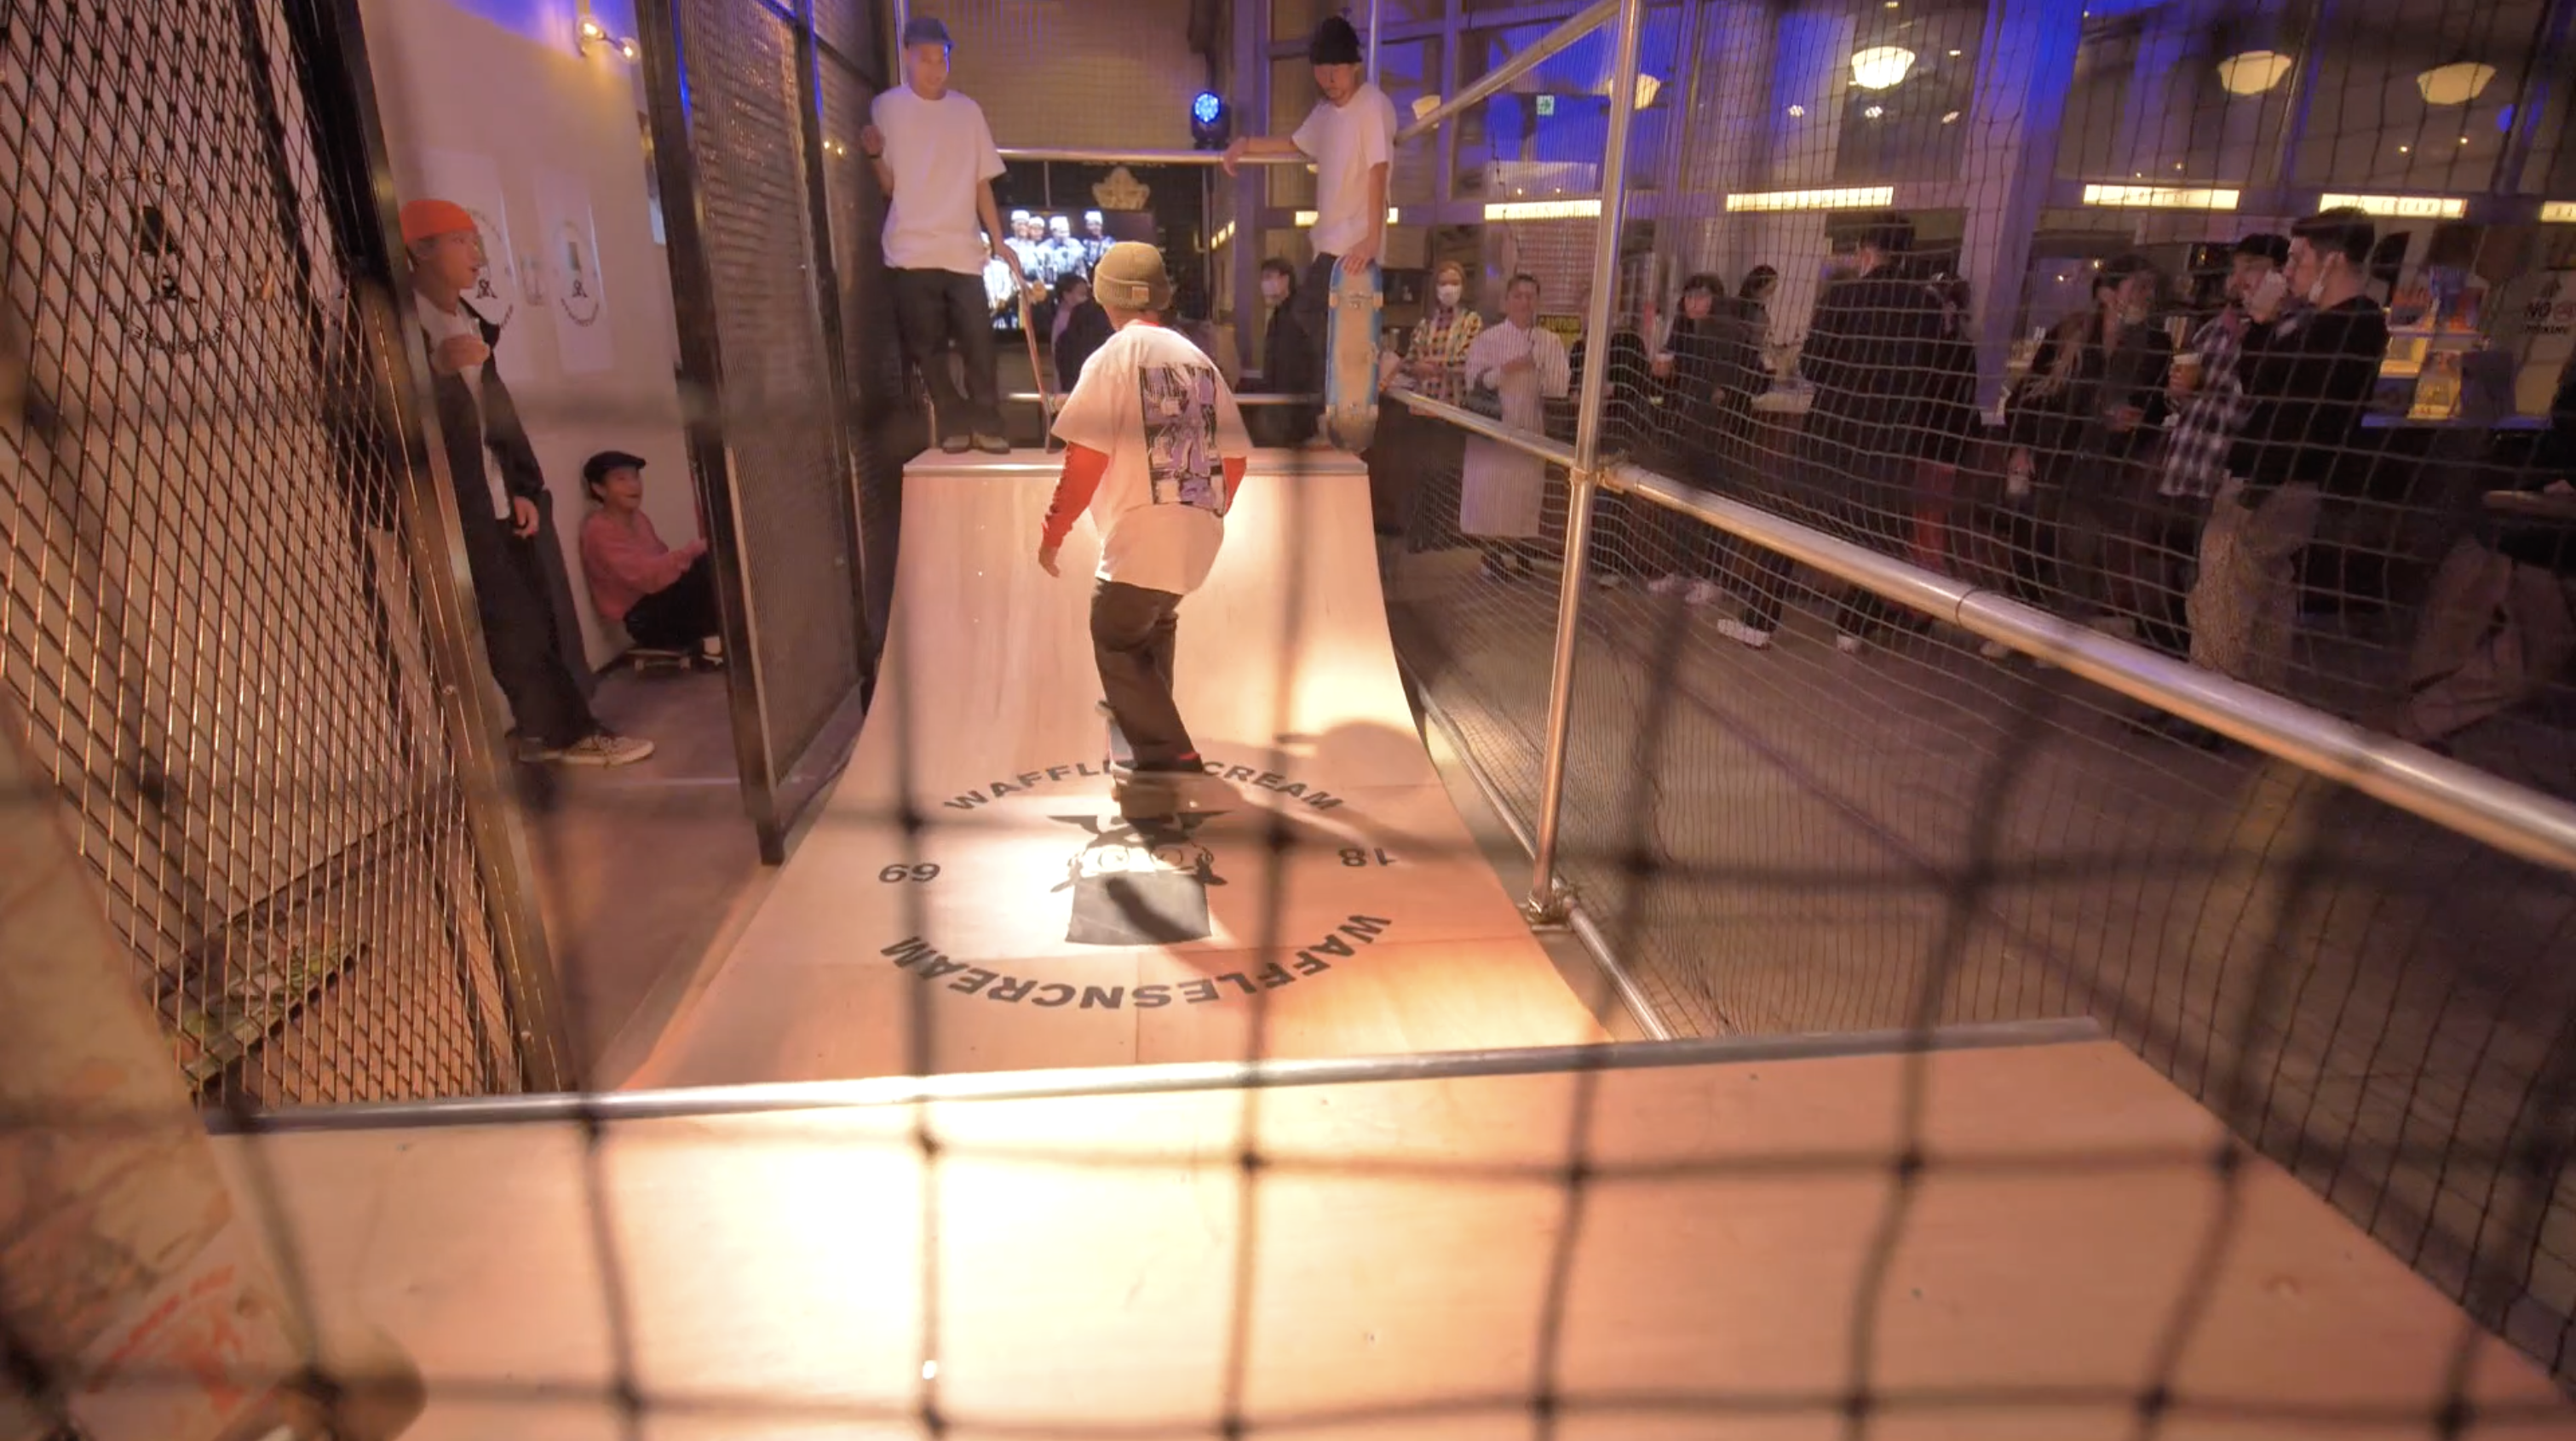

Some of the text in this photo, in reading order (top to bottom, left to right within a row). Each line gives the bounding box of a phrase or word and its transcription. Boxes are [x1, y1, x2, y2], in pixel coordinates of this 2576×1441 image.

[2525, 301, 2552, 320] NO
[879, 862, 941, 884] 69
[880, 913, 1394, 1009] WAFFLESNCREAM
